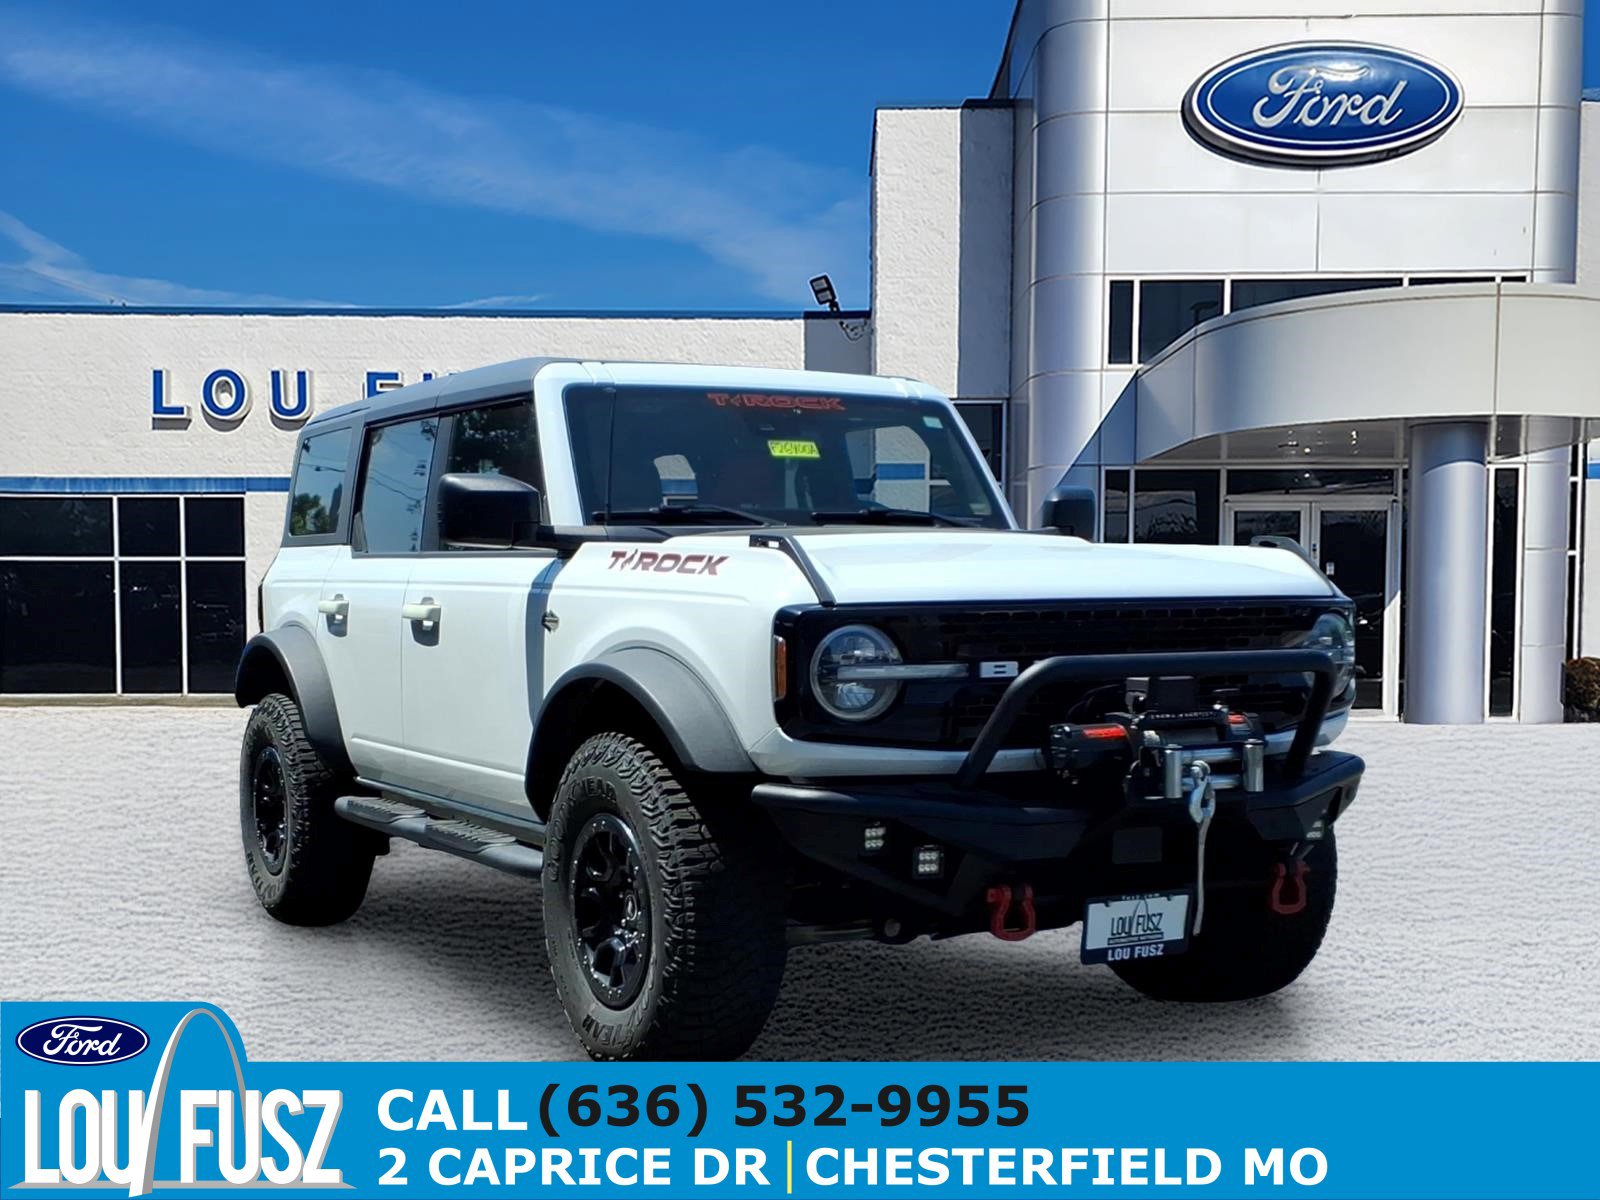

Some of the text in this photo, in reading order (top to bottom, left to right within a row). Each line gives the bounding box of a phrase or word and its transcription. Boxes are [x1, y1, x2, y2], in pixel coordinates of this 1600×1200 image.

[1252, 63, 1408, 128] Ford
[151, 368, 312, 420] LOU
[1111, 913, 1164, 937] LOU FUSZ
[1107, 943, 1165, 961] LOU FUSZ
